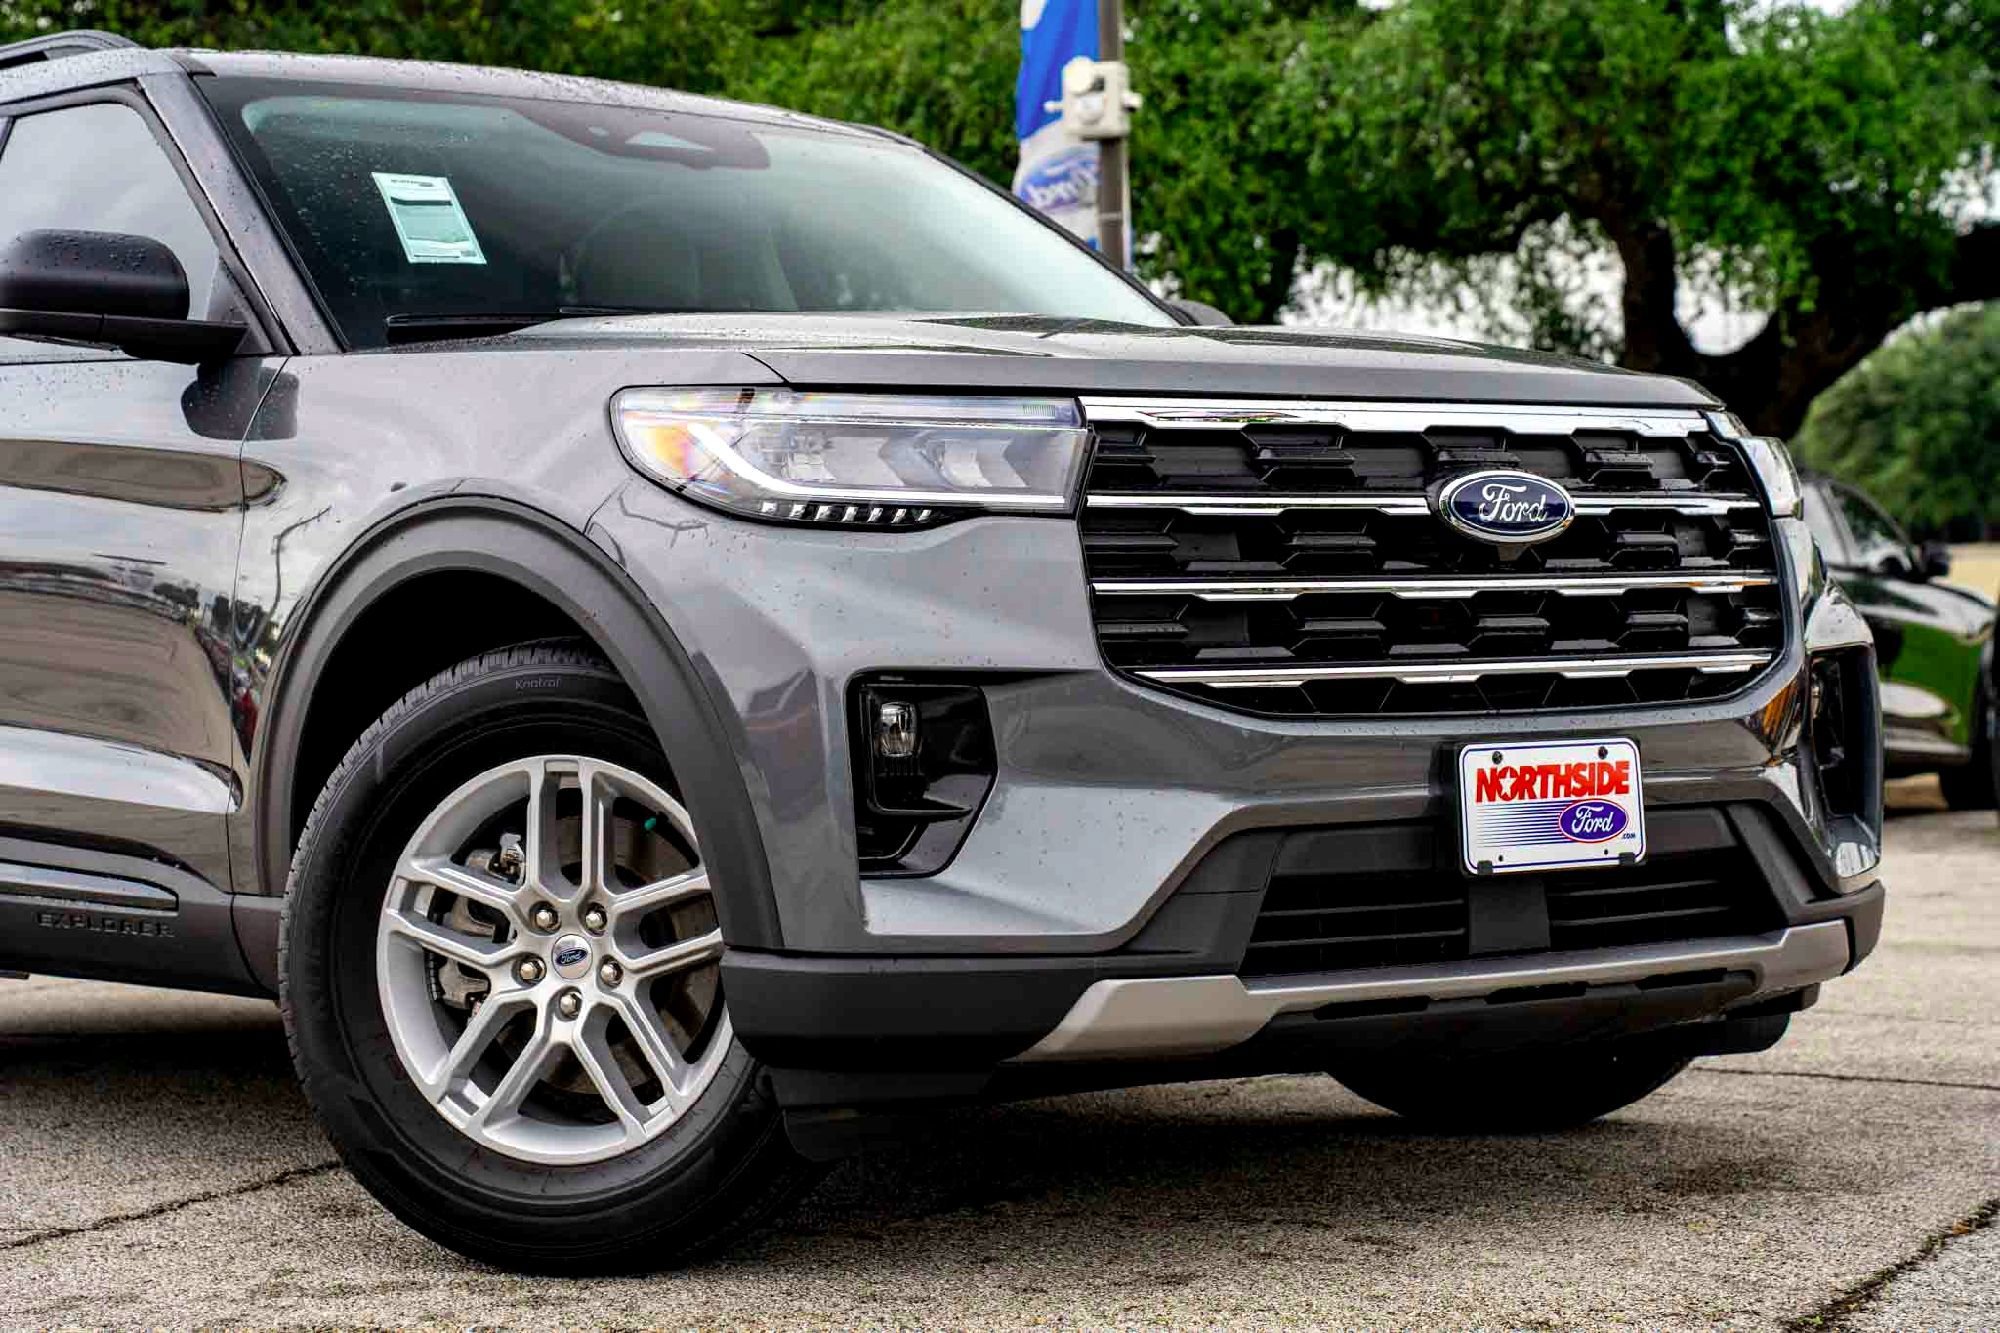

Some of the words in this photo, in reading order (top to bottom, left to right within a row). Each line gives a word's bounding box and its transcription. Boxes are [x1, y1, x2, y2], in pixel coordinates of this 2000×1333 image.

[1478, 483, 1549, 522] Ford
[1475, 760, 1631, 804] NORTHSIDE
[1571, 805, 1615, 833] Ford
[36, 912, 176, 938] EXPLORER
[560, 950, 582, 965] Ford
